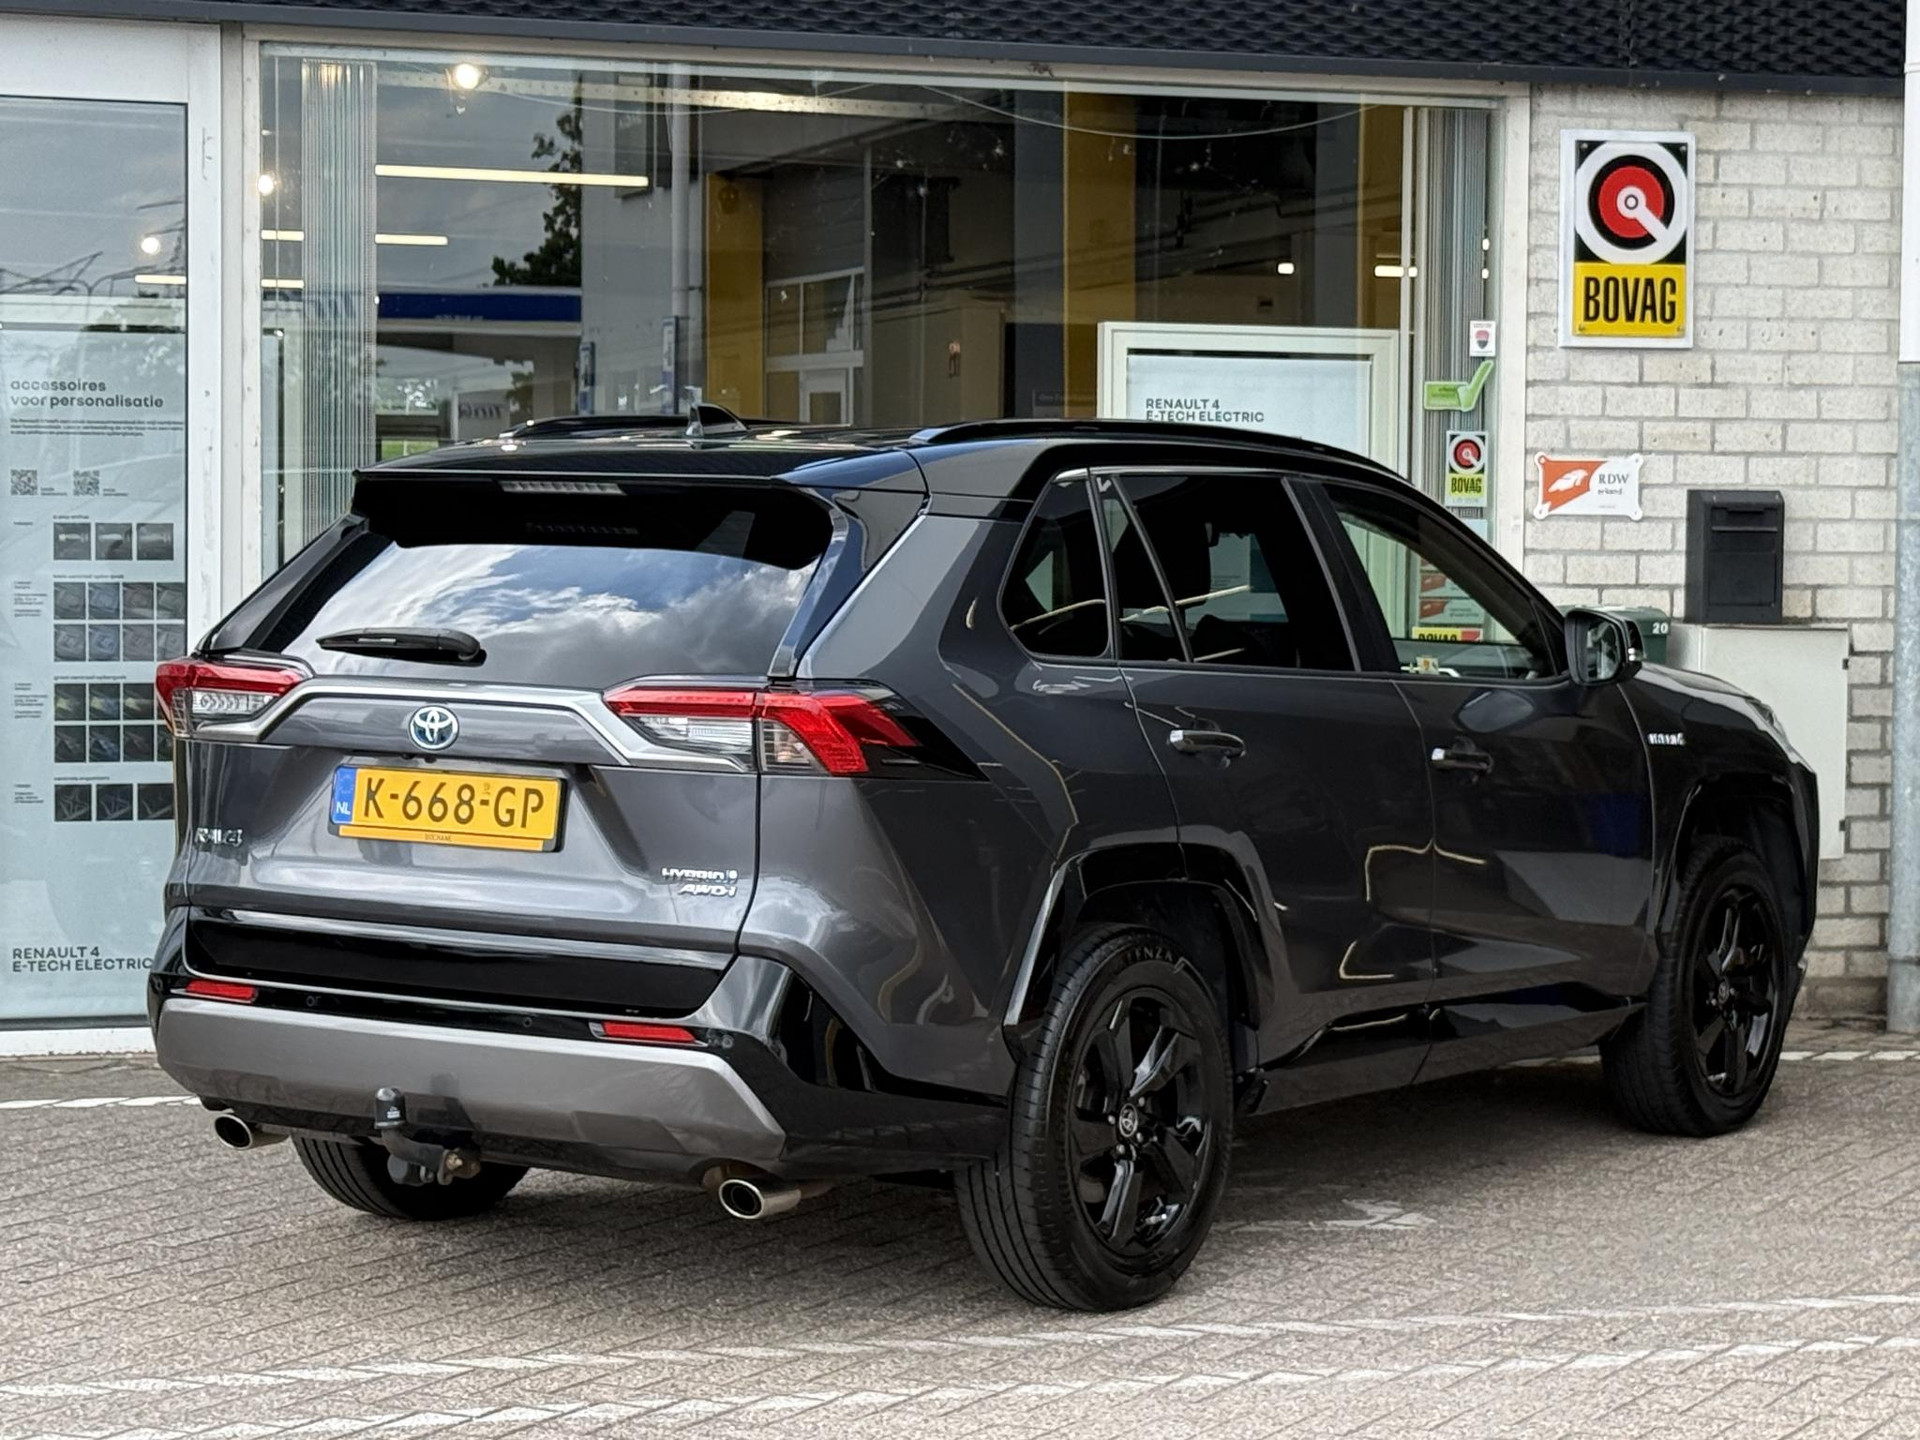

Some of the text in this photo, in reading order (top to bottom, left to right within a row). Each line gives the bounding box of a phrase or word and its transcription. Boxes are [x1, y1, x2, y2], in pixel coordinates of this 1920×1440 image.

[1583, 276, 1676, 324] BOVAG
[10, 379, 106, 392] accessoires
[11, 395, 164, 409] voor personalisatie
[1146, 398, 1220, 411] RENAULT 4
[1146, 410, 1265, 423] E-TECH ELECTRIC
[1451, 477, 1482, 493] BOVAG
[1598, 473, 1630, 484] RDW
[1652, 622, 1669, 634] 20
[335, 801, 352, 815] NL
[363, 777, 545, 828] K-668-GP
[12, 946, 100, 960] RENAULT 4
[12, 957, 154, 973] E-TECH ELECTRIC
